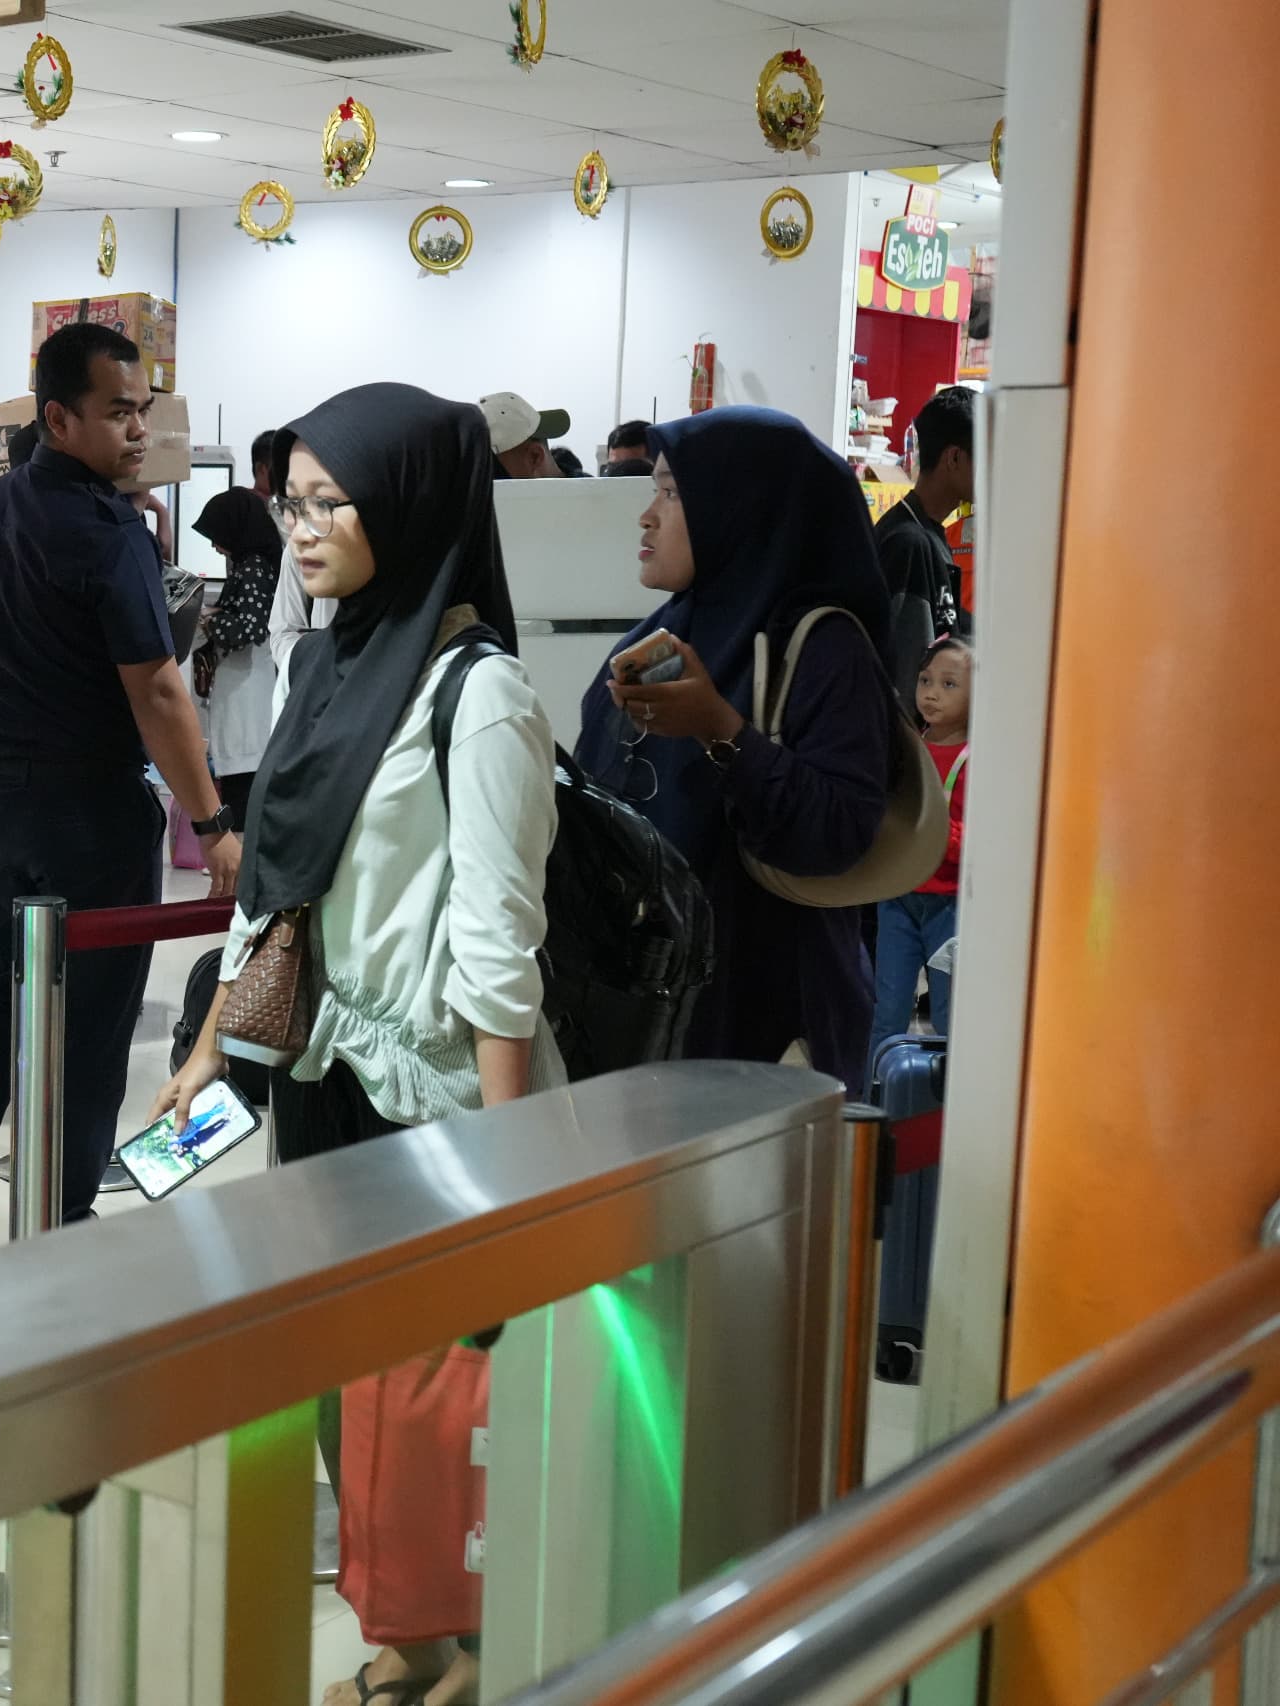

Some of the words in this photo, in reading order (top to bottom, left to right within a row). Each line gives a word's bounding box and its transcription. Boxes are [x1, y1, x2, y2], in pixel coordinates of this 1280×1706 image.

[907, 214, 936, 235] POCI
[886, 233, 906, 275] Es
[916, 234, 943, 280] Teh
